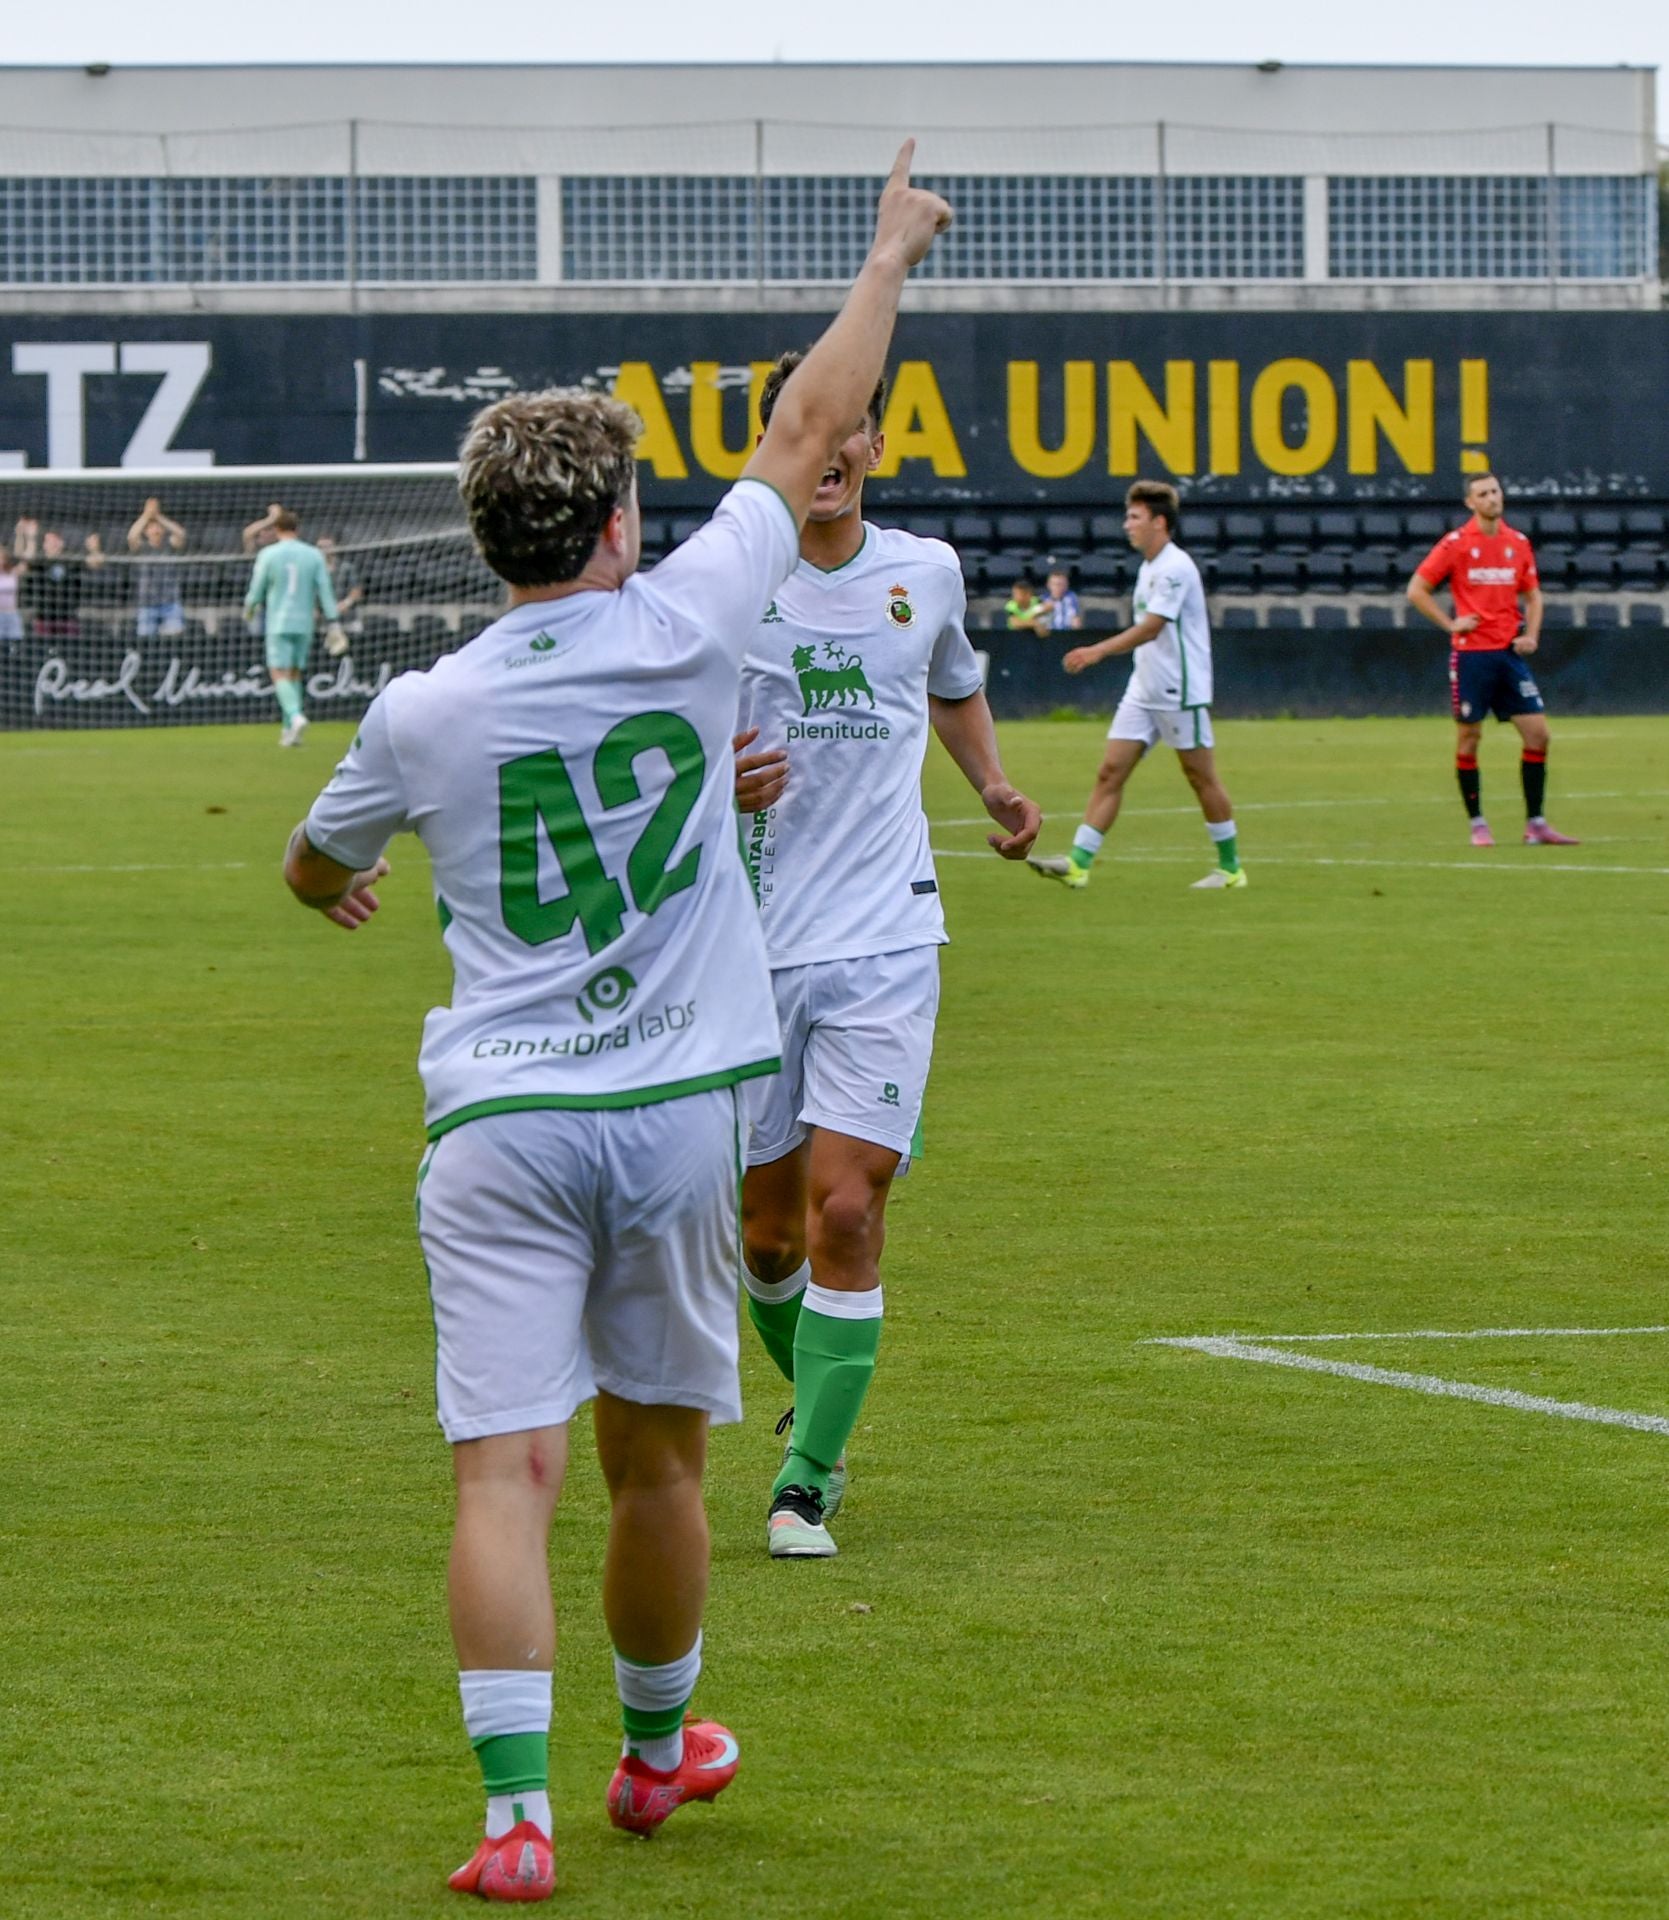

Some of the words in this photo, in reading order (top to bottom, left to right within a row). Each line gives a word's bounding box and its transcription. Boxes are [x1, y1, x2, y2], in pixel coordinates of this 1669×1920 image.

[0, 342, 215, 468] TZ
[611, 361, 967, 479] AUA
[1007, 358, 1489, 478] UNION!
[34, 649, 151, 715] Real
[787, 721, 890, 743] plenitude
[498, 710, 706, 958] 42
[762, 808, 777, 910] TELECO
[636, 1000, 697, 1043] labs
